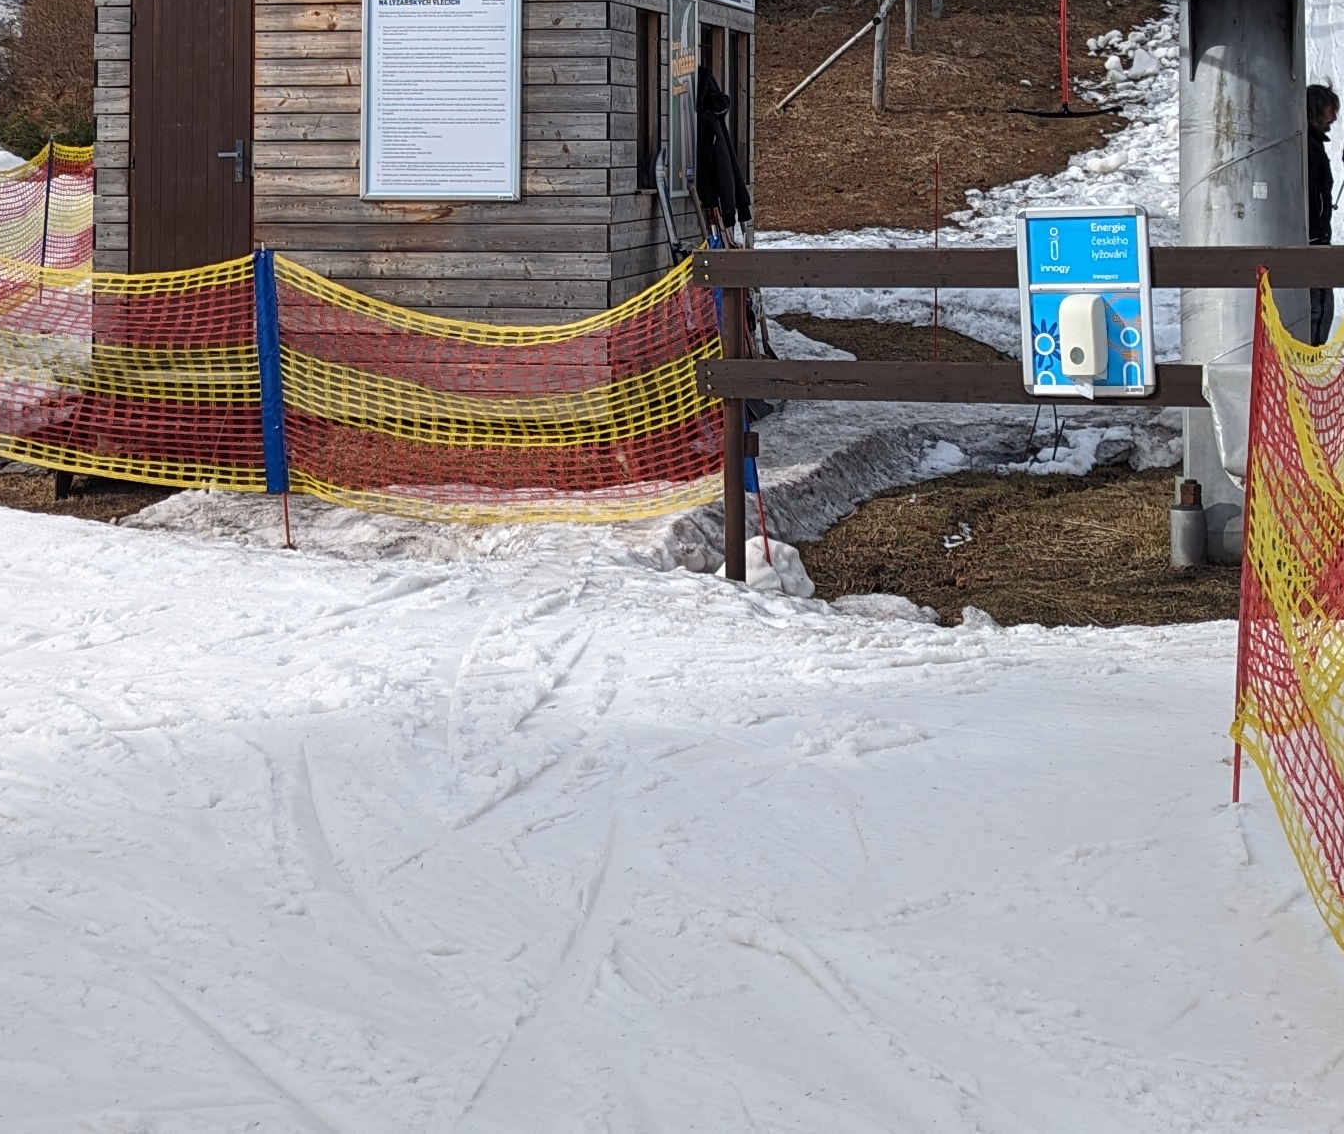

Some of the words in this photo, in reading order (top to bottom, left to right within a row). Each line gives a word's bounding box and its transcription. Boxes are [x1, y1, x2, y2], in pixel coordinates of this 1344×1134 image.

[1090, 222, 1127, 234] Energie
[1091, 235, 1129, 246] českého
[1091, 248, 1128, 261] lyžování
[1040, 263, 1071, 274] innogy
